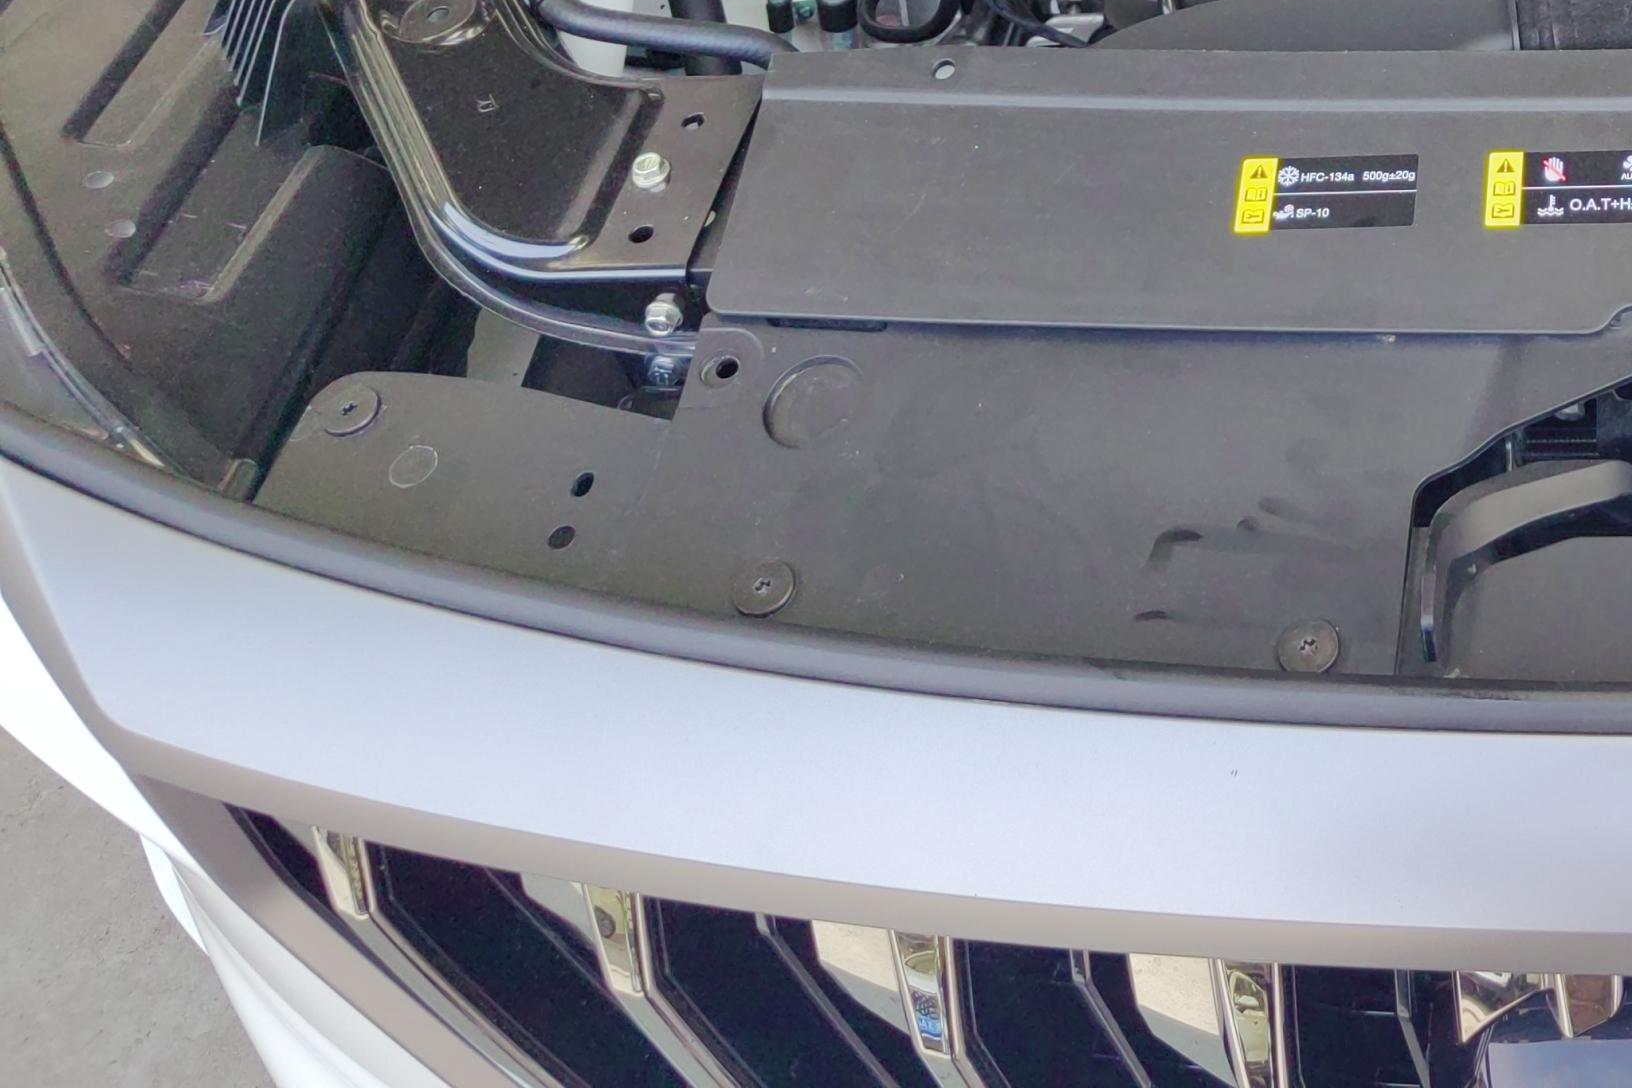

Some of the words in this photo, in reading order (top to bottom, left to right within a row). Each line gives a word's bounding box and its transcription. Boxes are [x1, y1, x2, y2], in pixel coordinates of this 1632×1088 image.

[1300, 171, 1355, 183] HFC-134a
[1362, 169, 1416, 183] 500g±20g
[1296, 207, 1330, 219] SP-10
